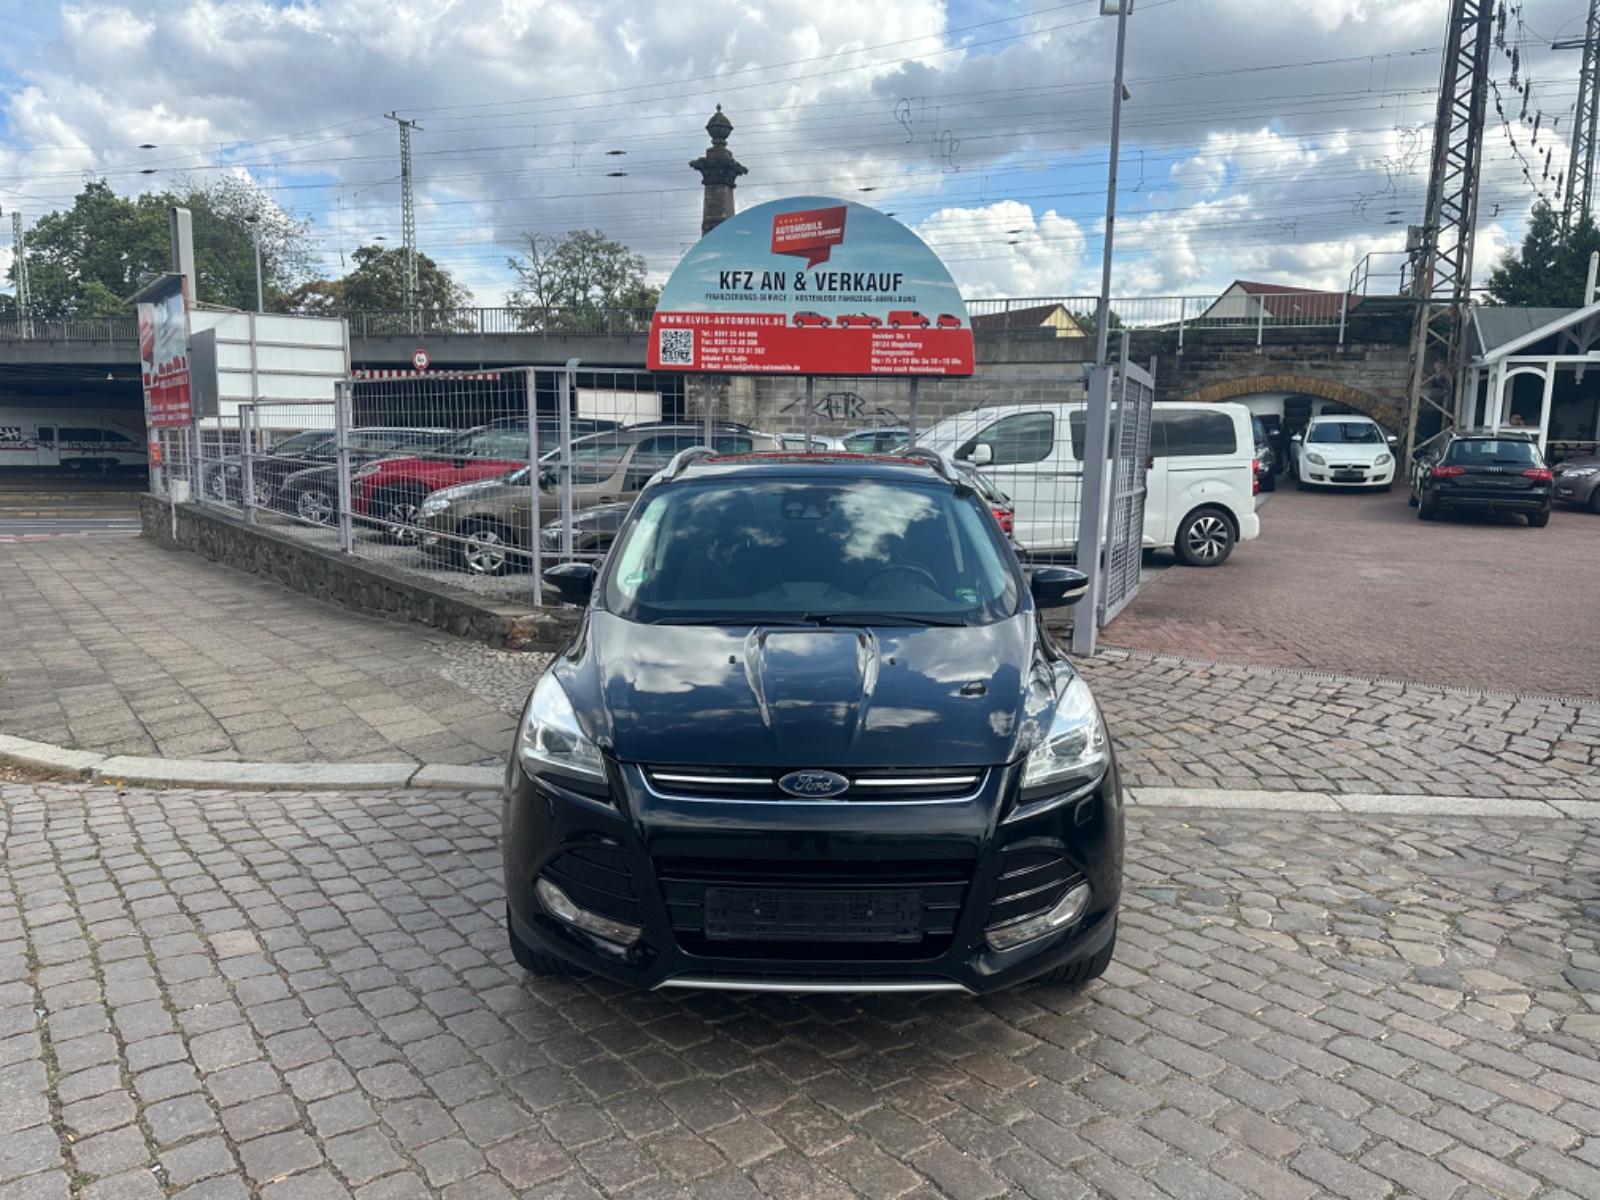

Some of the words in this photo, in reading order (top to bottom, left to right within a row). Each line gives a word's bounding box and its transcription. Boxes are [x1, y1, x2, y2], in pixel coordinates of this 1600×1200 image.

[776, 221, 823, 234] AUTOMOBILE
[719, 271, 753, 291] KFZ
[761, 271, 786, 291] AN
[794, 271, 807, 291] &
[815, 272, 904, 292] VERKAUF
[705, 293, 787, 302] FINANZIERUNGS-SERVICE
[795, 294, 837, 303] KOSTENLOSE
[660, 315, 785, 326] WWW.ELVIS-AUTOMOBILE.DE
[794, 774, 833, 791] Ford
